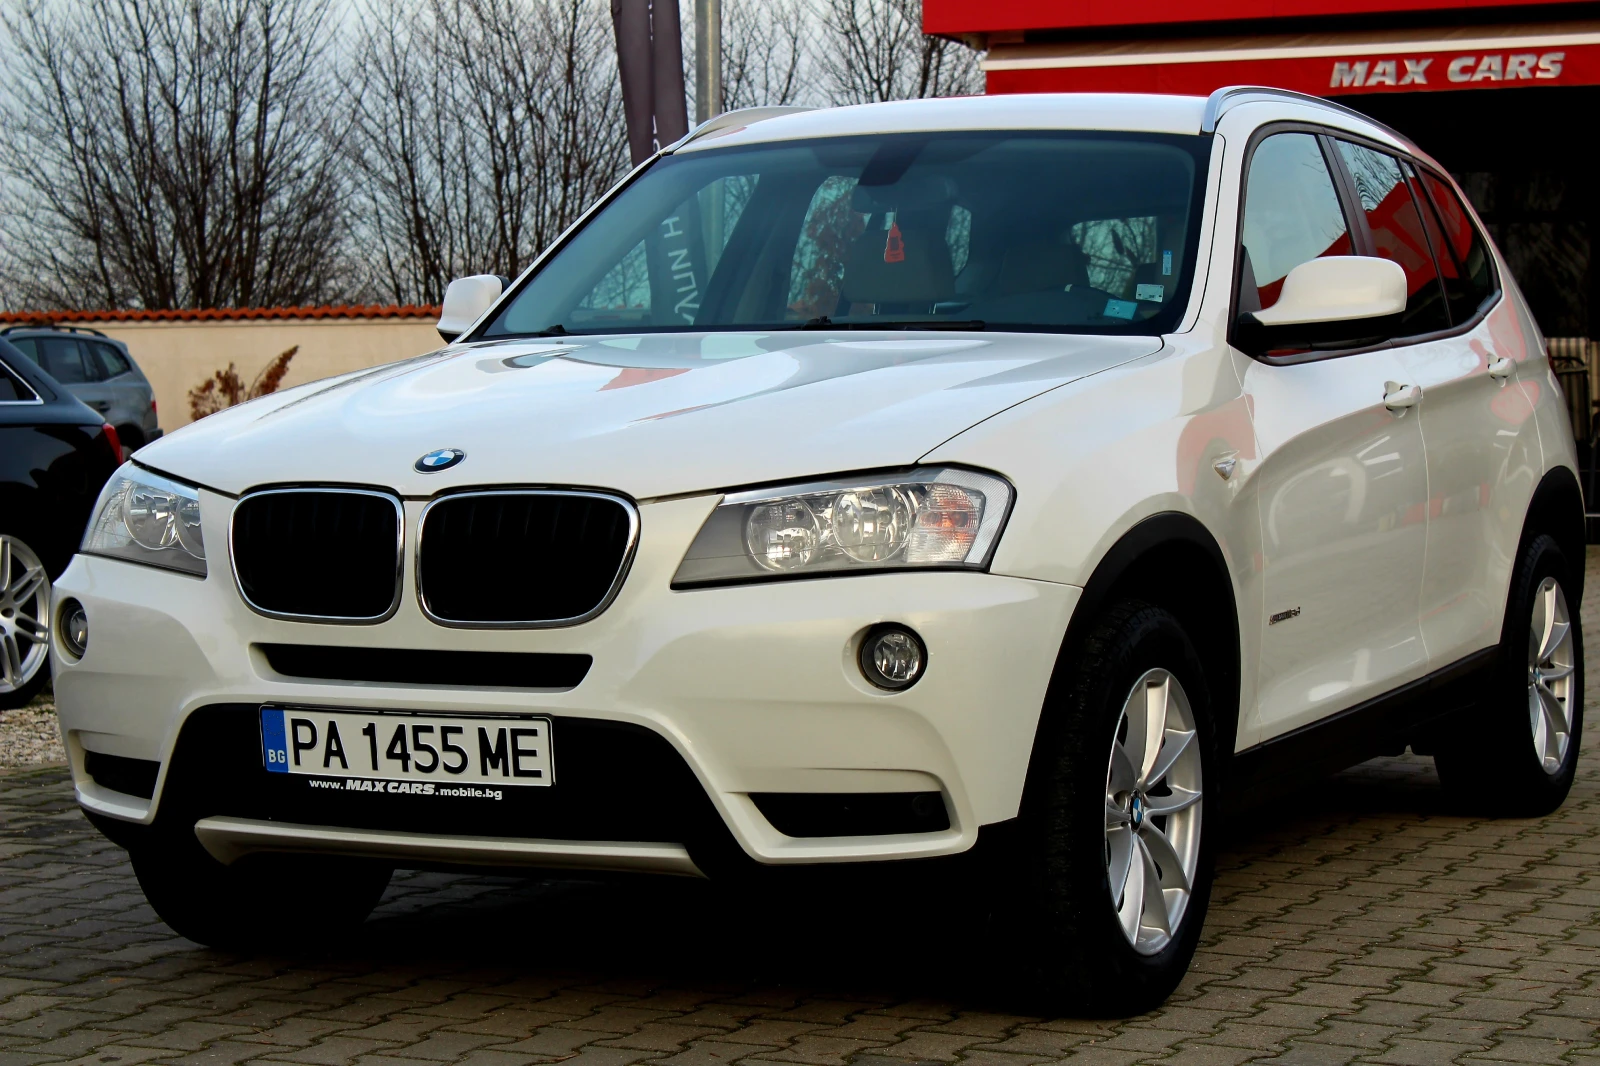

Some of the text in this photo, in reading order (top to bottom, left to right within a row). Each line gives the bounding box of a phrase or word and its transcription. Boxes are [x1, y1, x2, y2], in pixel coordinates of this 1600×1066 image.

[1329, 51, 1566, 88] MAX CARS
[268, 749, 286, 763] BG
[291, 718, 543, 778] PA 1455 ME
